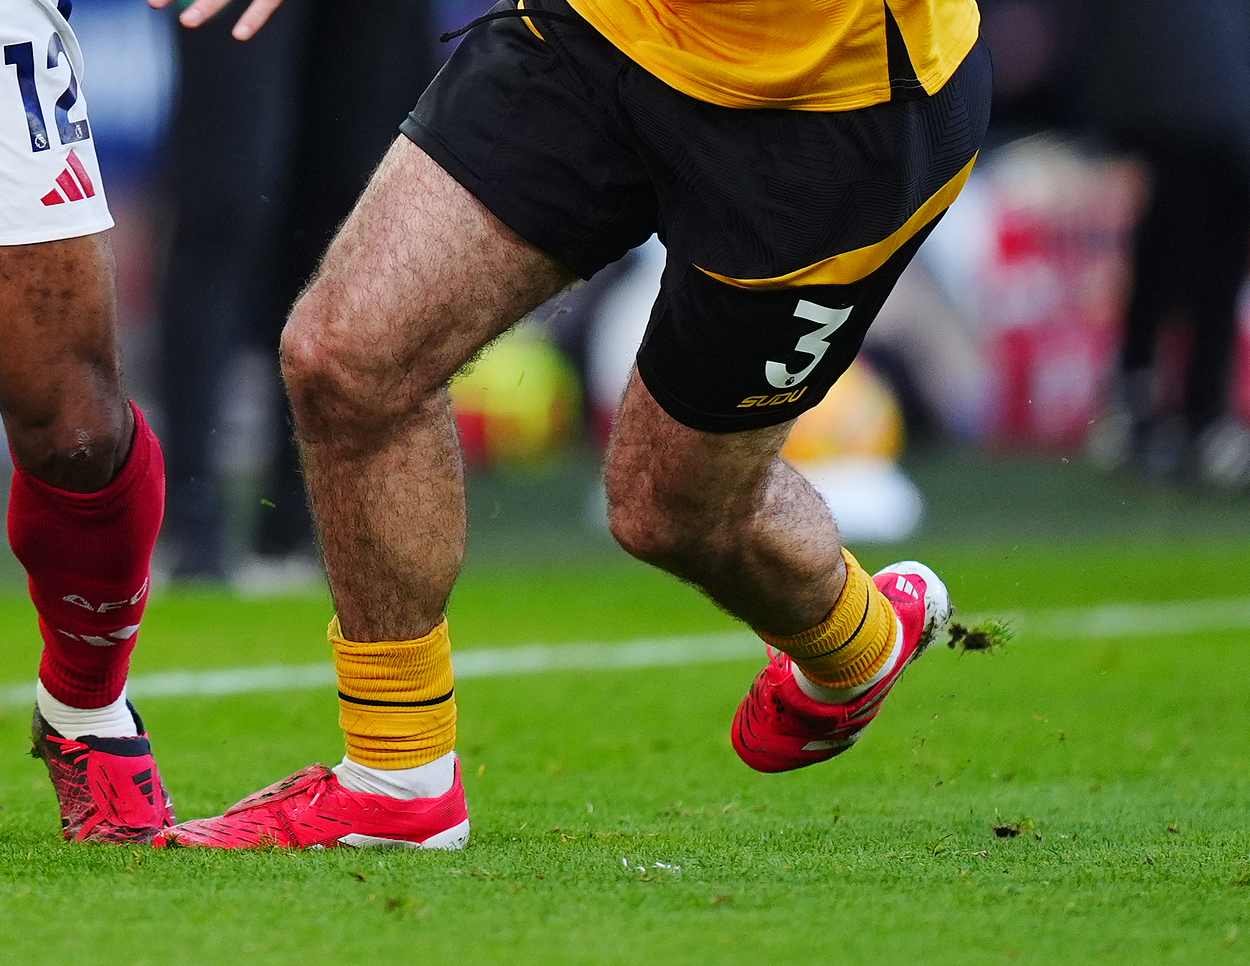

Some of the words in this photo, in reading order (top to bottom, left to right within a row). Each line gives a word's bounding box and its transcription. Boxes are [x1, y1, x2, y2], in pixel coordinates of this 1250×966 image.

[3, 31, 91, 153] 12
[765, 299, 854, 389] 3
[736, 386, 808, 408] SUDU
